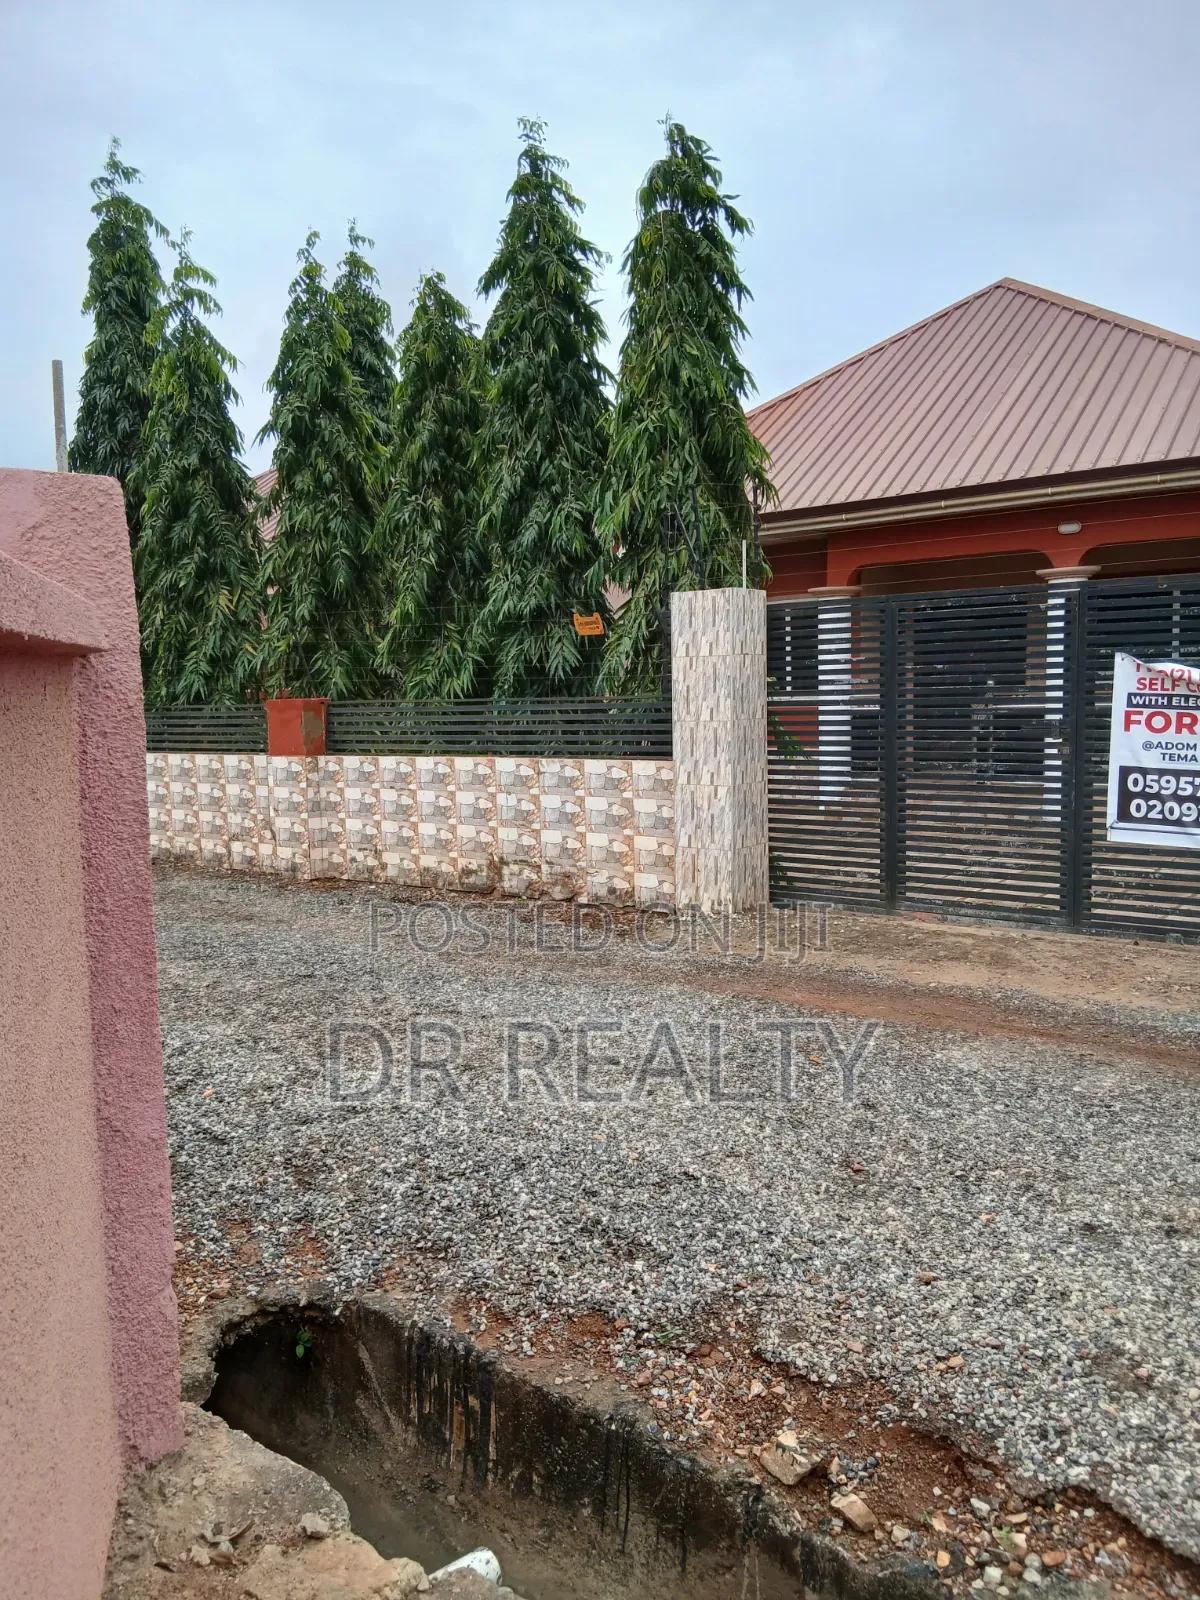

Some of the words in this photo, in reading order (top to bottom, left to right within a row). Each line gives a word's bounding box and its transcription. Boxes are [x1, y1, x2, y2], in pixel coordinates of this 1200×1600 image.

[1136, 676, 1180, 692] SELF
[1131, 695, 1168, 706] WITH
[1124, 709, 1199, 735] FOR
[1142, 740, 1197, 752] @ADOM
[1160, 752, 1199, 763] TEMA
[1129, 798, 1200, 822] 0209
